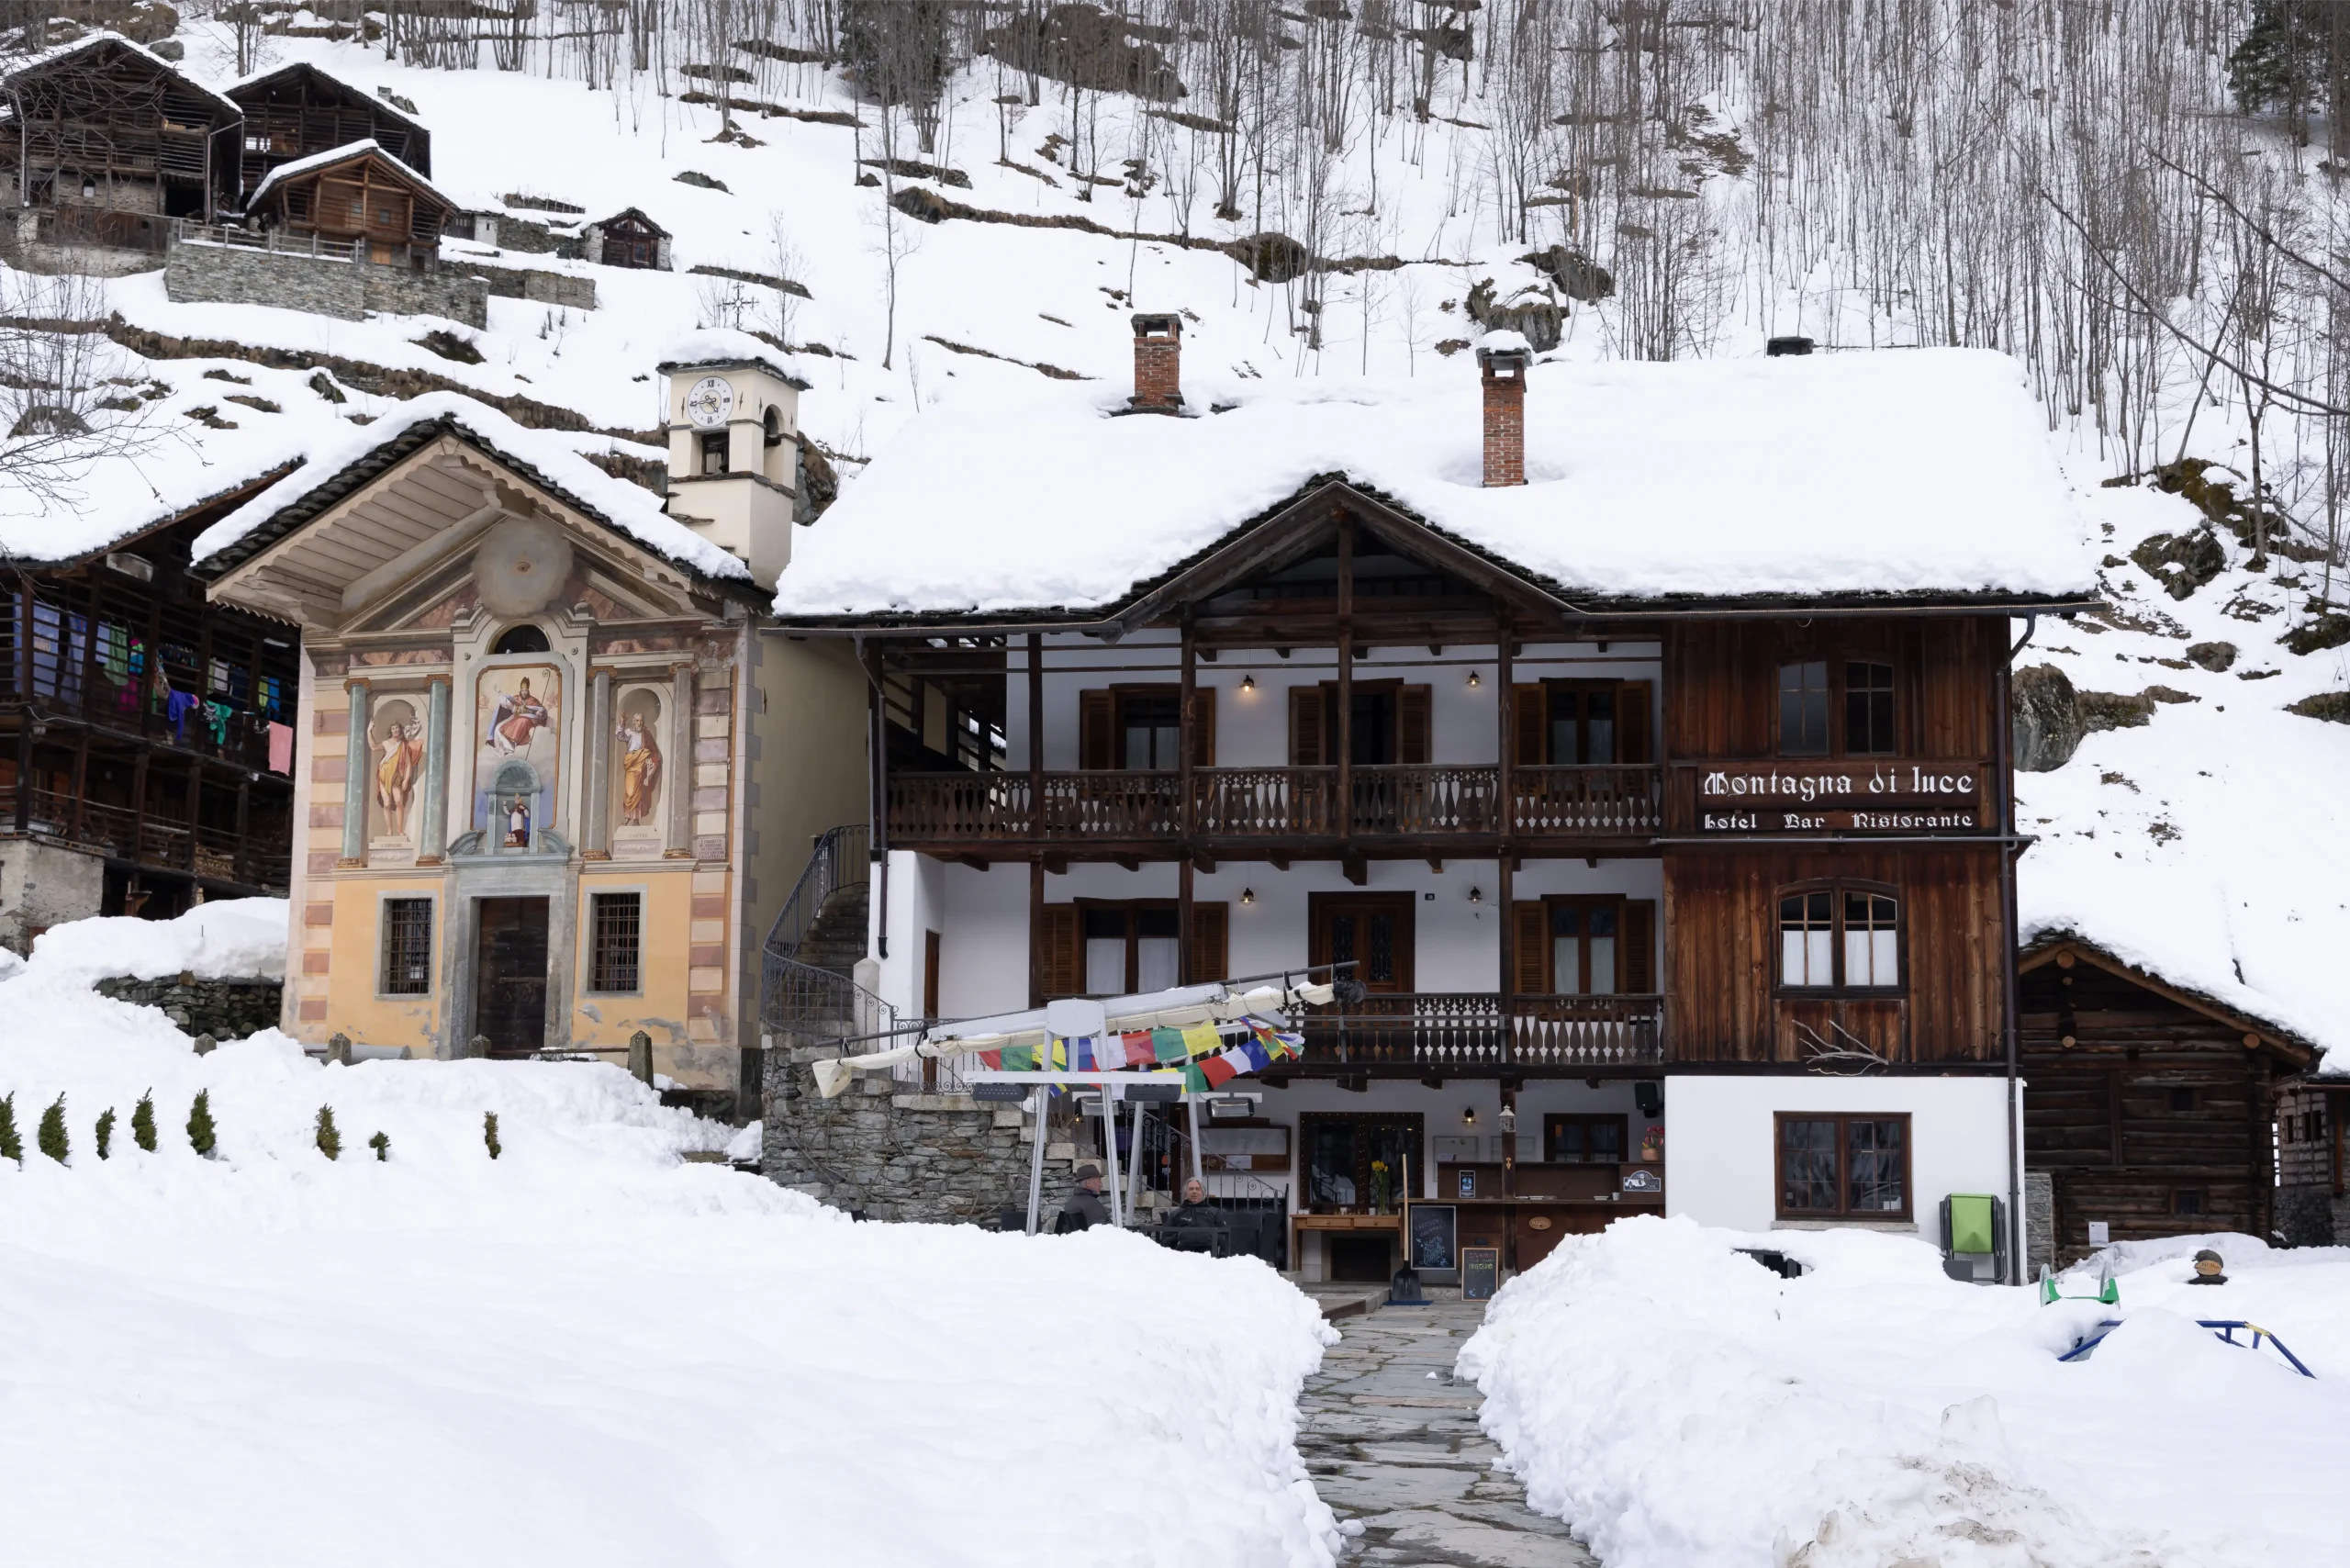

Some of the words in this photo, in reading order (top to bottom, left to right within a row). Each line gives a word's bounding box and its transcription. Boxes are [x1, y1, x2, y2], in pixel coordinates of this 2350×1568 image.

[1705, 768, 1852, 801] Montagna
[1869, 765, 1897, 793] di
[1912, 767, 1973, 792] luce
[1784, 813, 1824, 828] Bar
[1852, 813, 1972, 828] Ristorante
